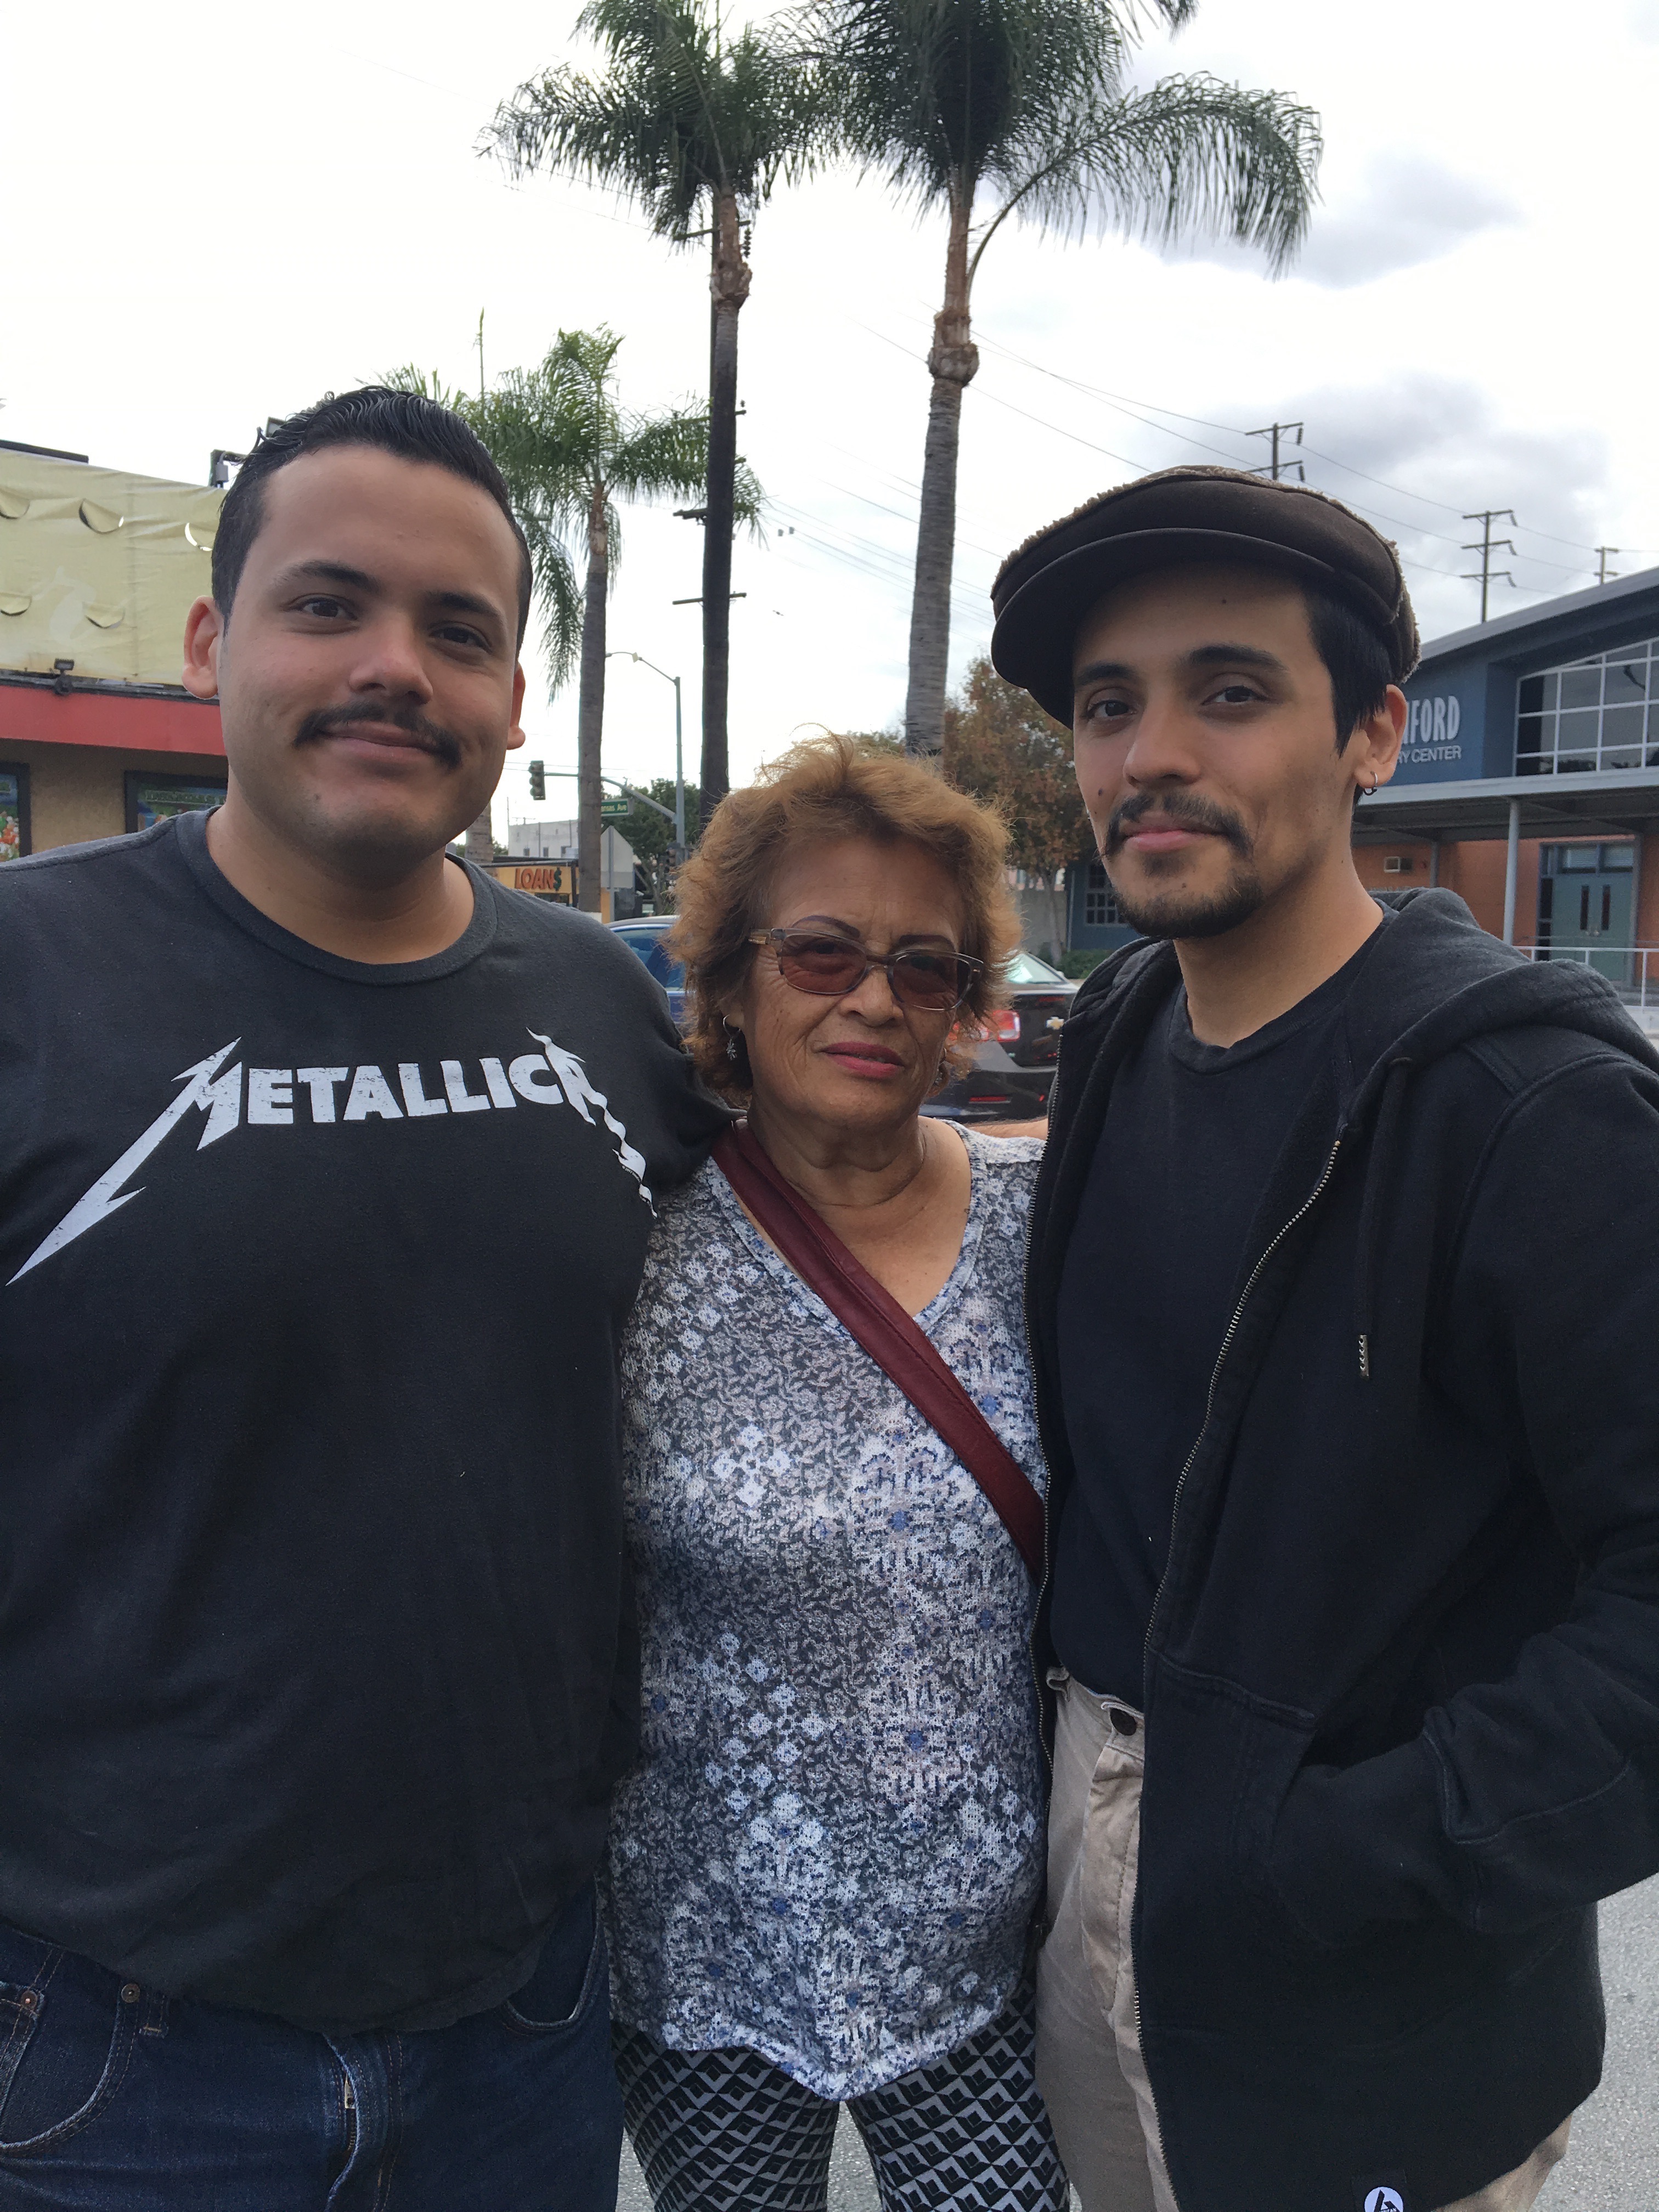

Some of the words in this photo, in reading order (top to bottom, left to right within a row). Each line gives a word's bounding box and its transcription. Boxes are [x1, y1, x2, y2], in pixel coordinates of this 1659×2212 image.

[1404, 696, 1460, 744] FORD
[1411, 746, 1462, 763] CENTER
[5, 1028, 657, 1286] METALLICA
